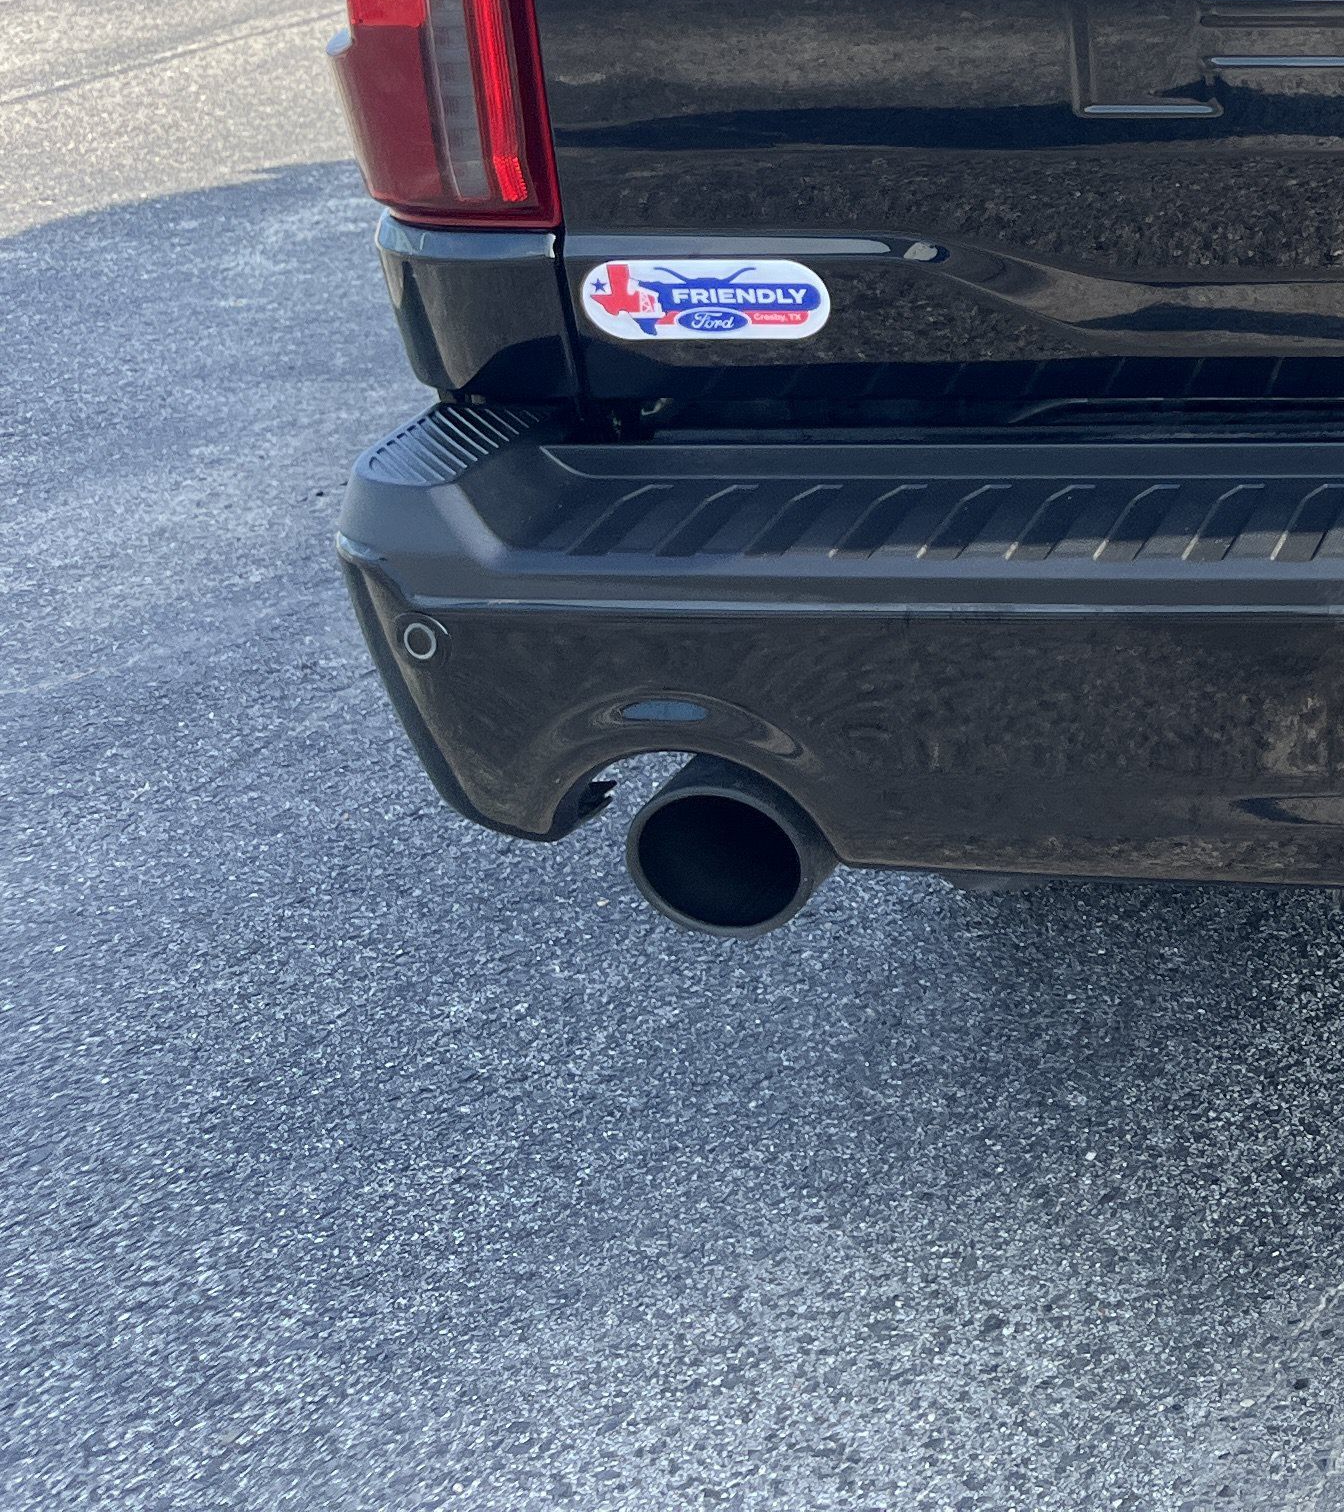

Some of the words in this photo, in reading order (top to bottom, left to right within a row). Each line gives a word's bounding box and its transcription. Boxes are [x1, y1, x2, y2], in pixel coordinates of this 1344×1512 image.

[673, 289, 807, 304] FRIENDLY
[692, 312, 734, 328] Ford
[753, 312, 786, 322] Crosby,
[789, 313, 801, 321] TX
